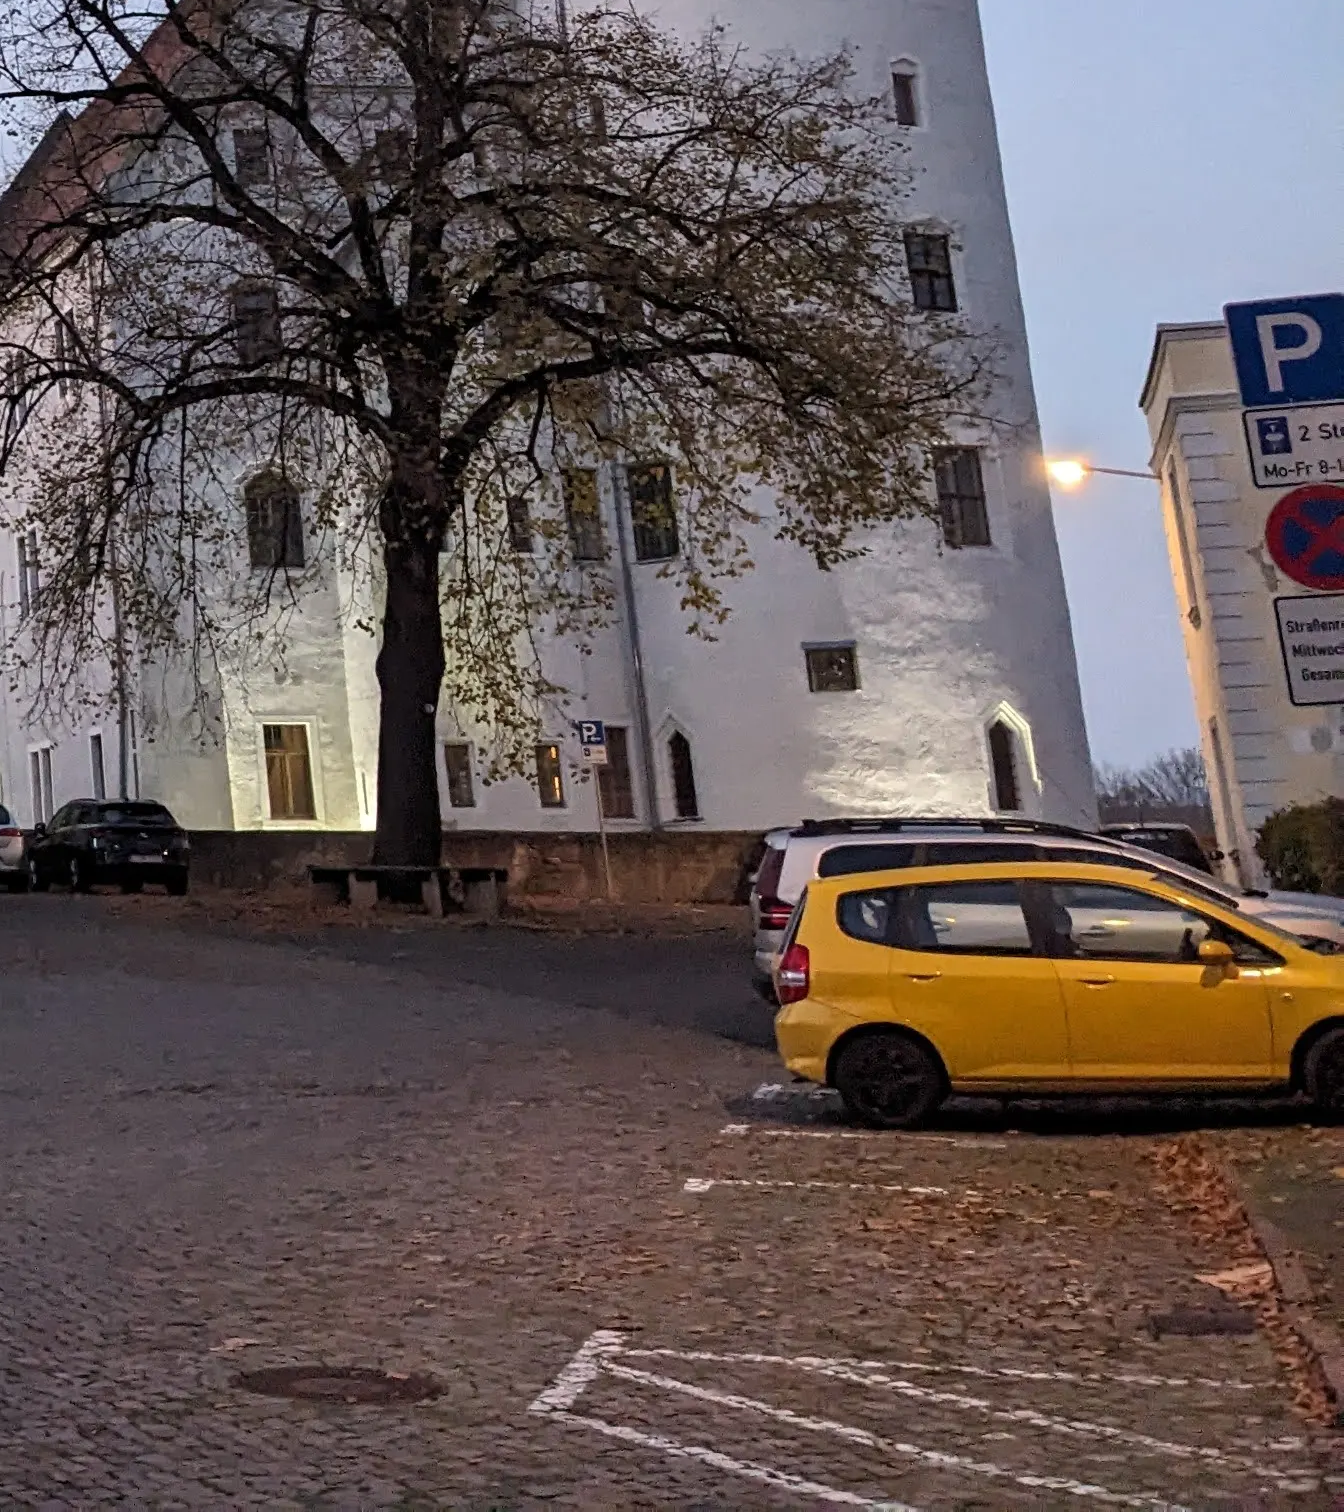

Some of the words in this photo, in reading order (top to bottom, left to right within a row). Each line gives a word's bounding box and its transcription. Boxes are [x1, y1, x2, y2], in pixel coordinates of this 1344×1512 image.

[1255, 312, 1322, 392] P
[1298, 425, 1311, 441] 2
[1264, 460, 1313, 478] Mo-Fr
[1319, 458, 1344, 474] 8-1
